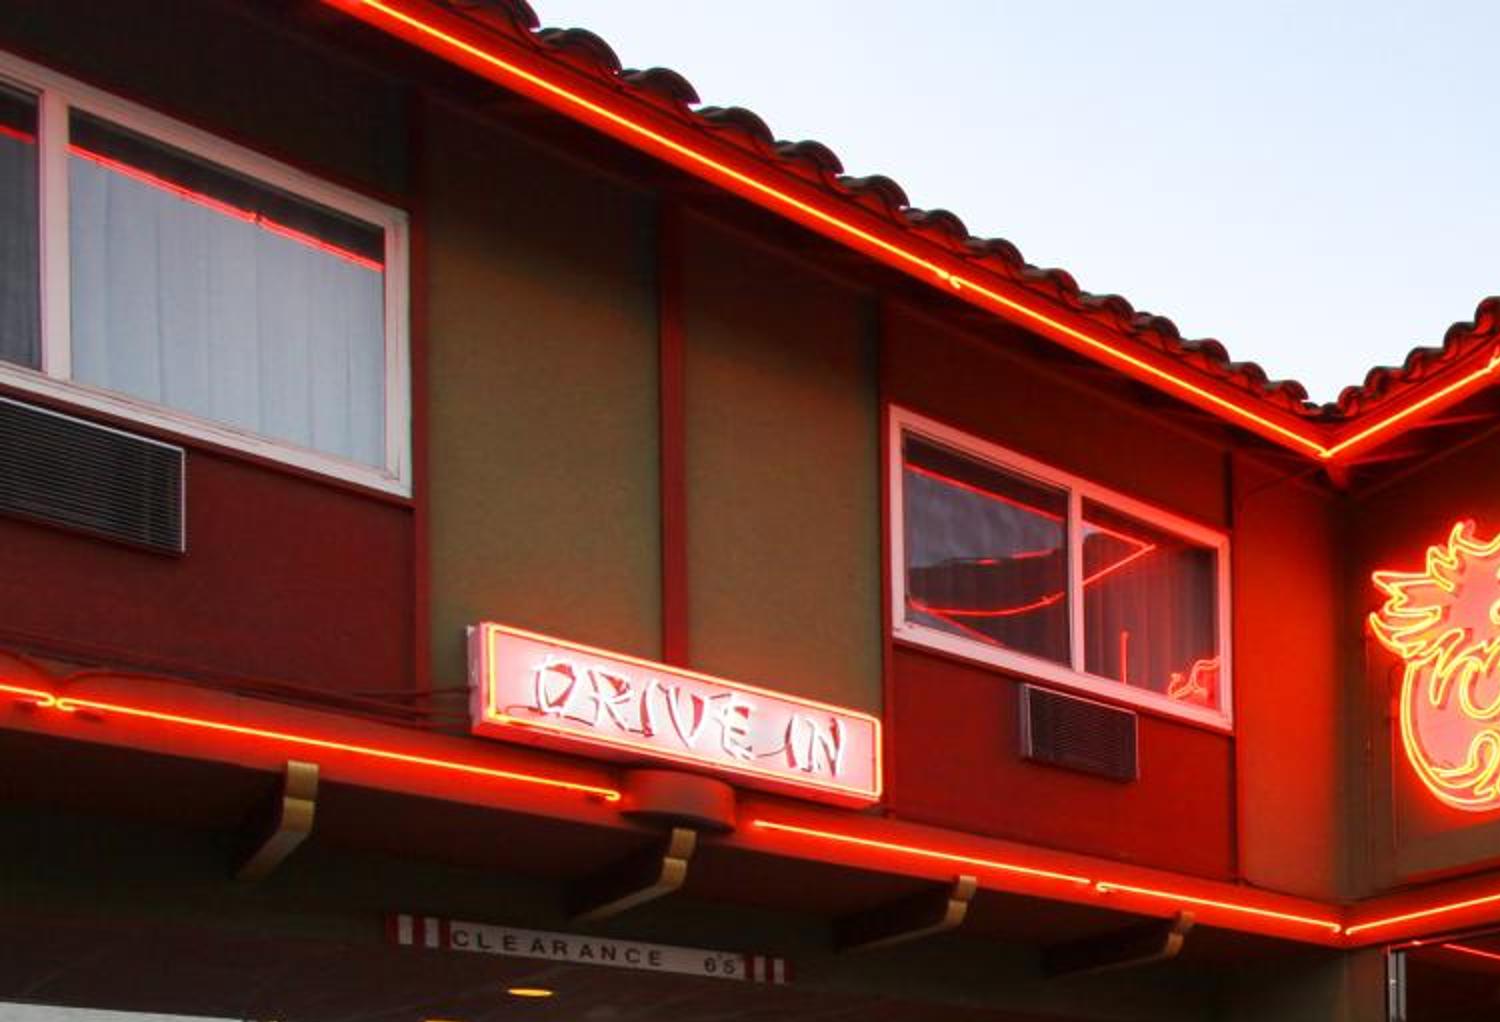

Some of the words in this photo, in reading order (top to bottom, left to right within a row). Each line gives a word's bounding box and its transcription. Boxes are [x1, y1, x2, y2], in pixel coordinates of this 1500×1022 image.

[532, 653, 754, 760] DRIVE
[783, 712, 846, 778] IN
[451, 928, 664, 967] CLEARANCE
